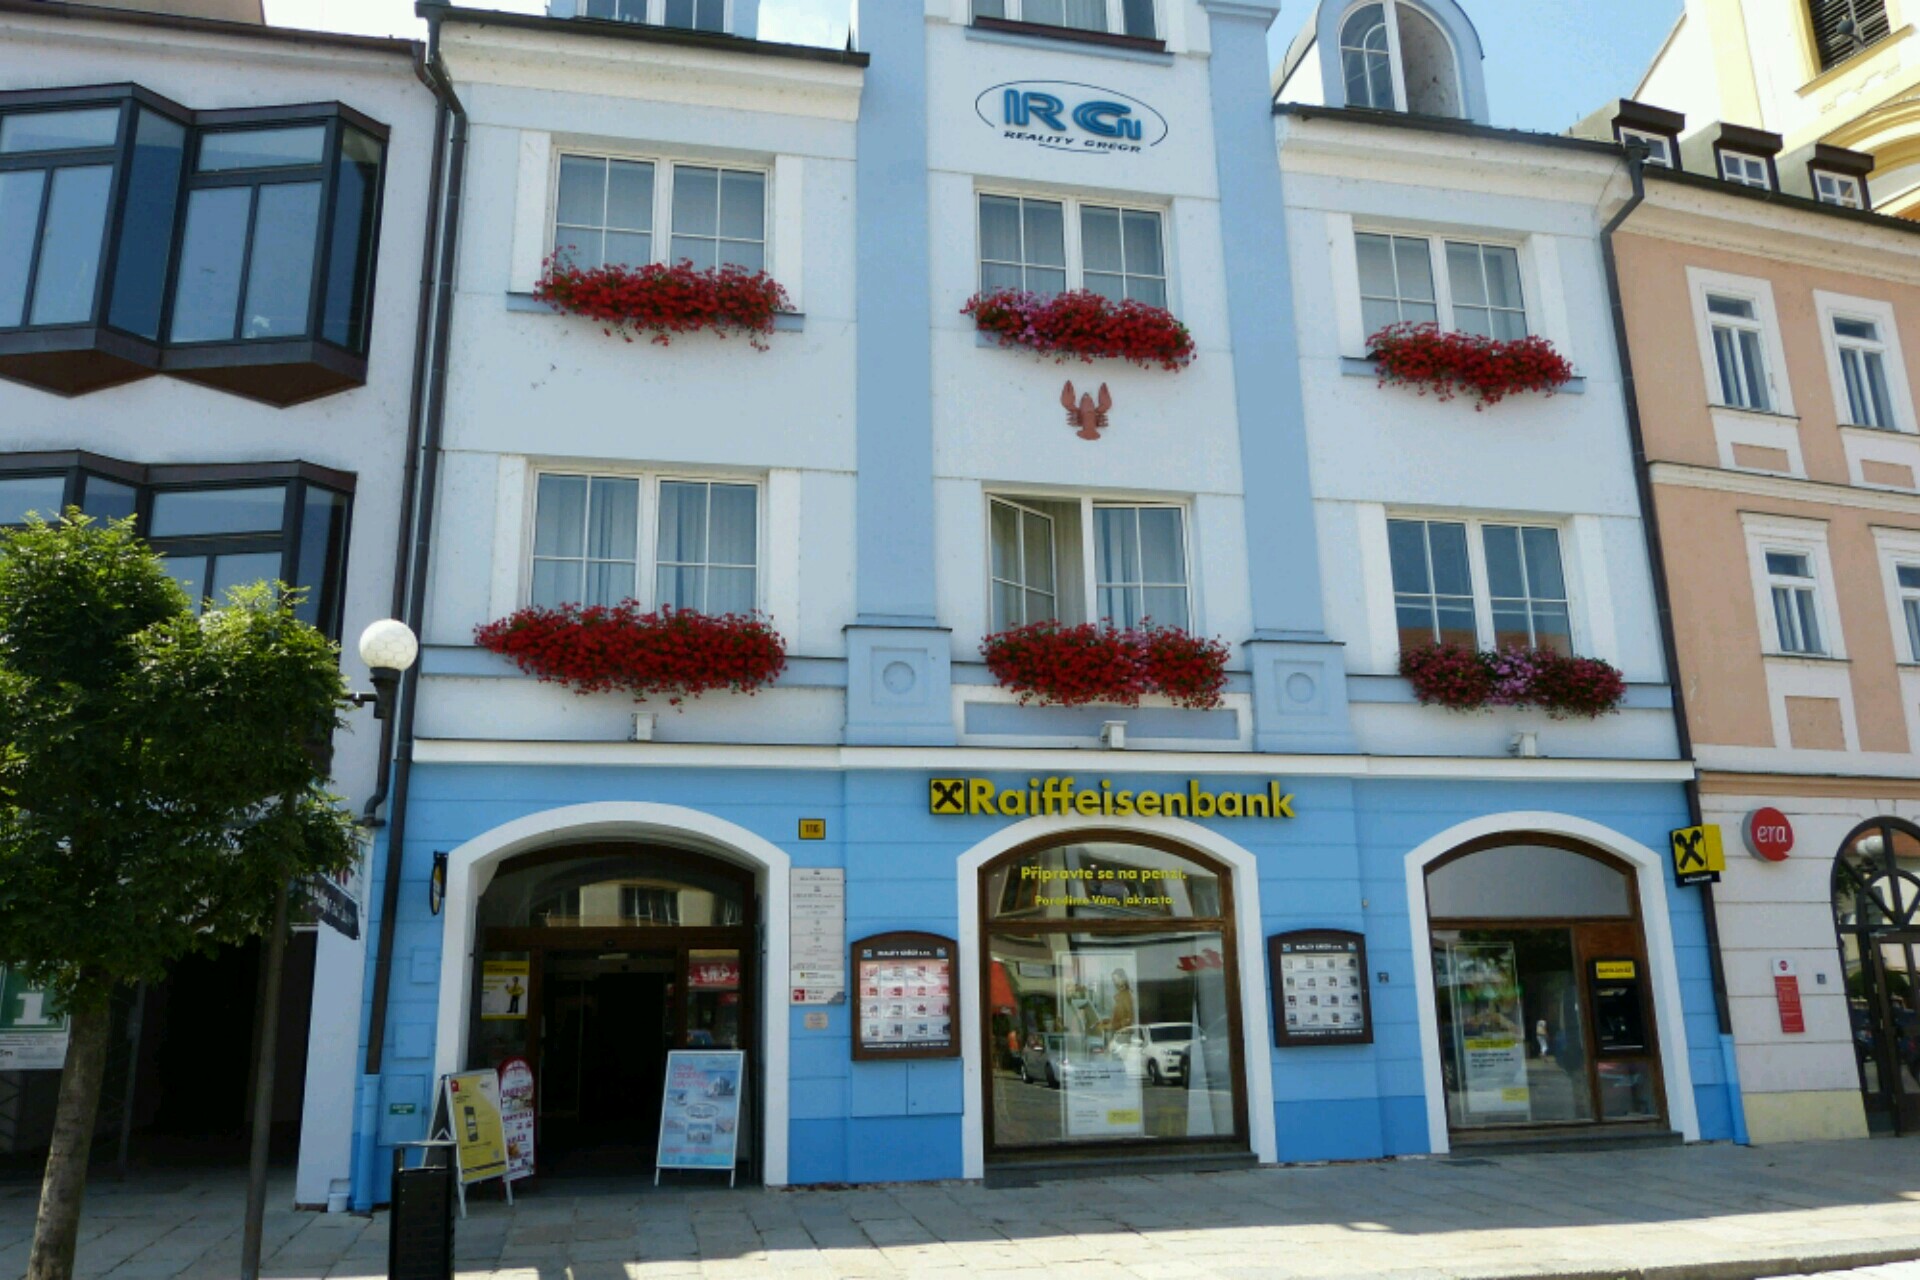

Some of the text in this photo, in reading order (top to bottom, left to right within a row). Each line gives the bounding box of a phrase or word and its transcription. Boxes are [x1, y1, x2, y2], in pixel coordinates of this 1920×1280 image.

[1003, 131, 1075, 144] REALITY
[968, 777, 1296, 818] Raiffeisenbank
[1757, 825, 1787, 843] era
[1097, 870, 1114, 880] se
[1118, 870, 1137, 879] na
